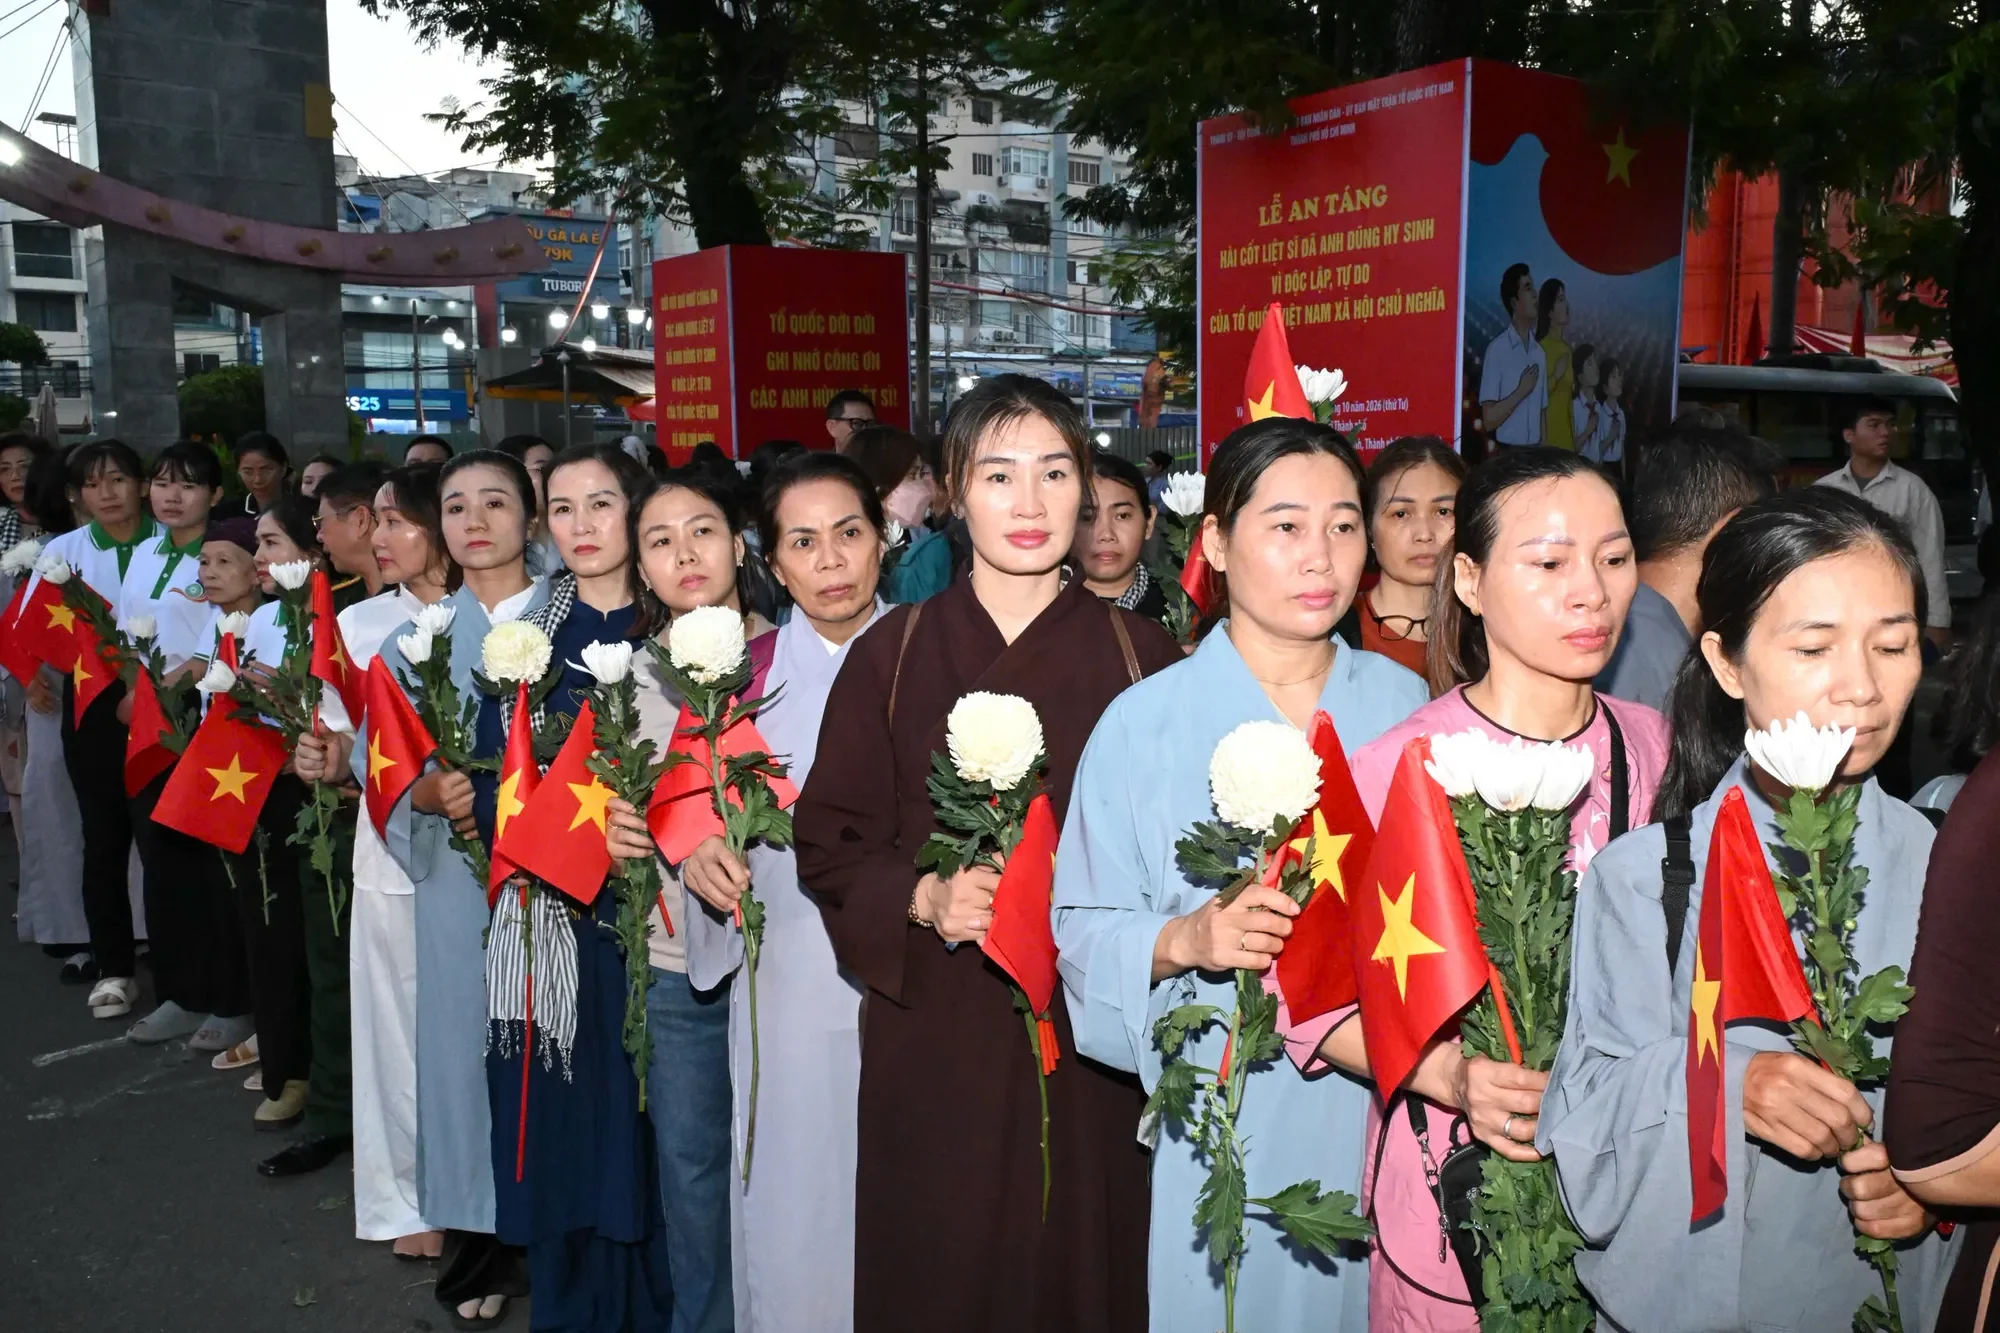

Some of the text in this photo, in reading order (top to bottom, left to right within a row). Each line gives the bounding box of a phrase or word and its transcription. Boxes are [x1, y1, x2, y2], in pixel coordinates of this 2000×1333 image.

[1259, 184, 1388, 226] LỄ AN TÁNG
[548, 224, 567, 242] GÀ
[1220, 246, 1237, 269] HÀI
[1240, 239, 1260, 266] CỐT
[1262, 238, 1284, 266] LIỆT
[1302, 233, 1316, 257] ĐÃ
[1320, 236, 1343, 256] ANH
[1348, 226, 1379, 251] DŨNG
[1384, 224, 1400, 246] HY
[1404, 218, 1434, 242] SINH
[543, 246, 573, 261] 79K
[1272, 263, 1370, 296] VÌ ĐỘC LẬP, TỰ DO
[770, 306, 875, 336] TỔ QUỐC ĐỜI ĐỜI
[1210, 308, 1230, 334] CỦA
[1232, 304, 1246, 331] TỔ
[1305, 302, 1331, 323] NAM
[1334, 298, 1350, 320] XÃ
[1354, 298, 1374, 323] HỘI
[1377, 288, 1401, 317] CHỦ
[1406, 287, 1446, 312] NGHĨA
[767, 348, 881, 371] GHI NHỚ CÔNG ƠN
[346, 396, 380, 411] S25
[750, 384, 777, 409] CÁC
[782, 388, 809, 408] ANH
[1342, 402, 1349, 413] 10
[1350, 402, 1365, 412] năm
[1366, 400, 1382, 413] 2026
[1382, 399, 1397, 413] (thứ
[1398, 398, 1409, 412] Tư)
[1365, 436, 1385, 450] Thành
